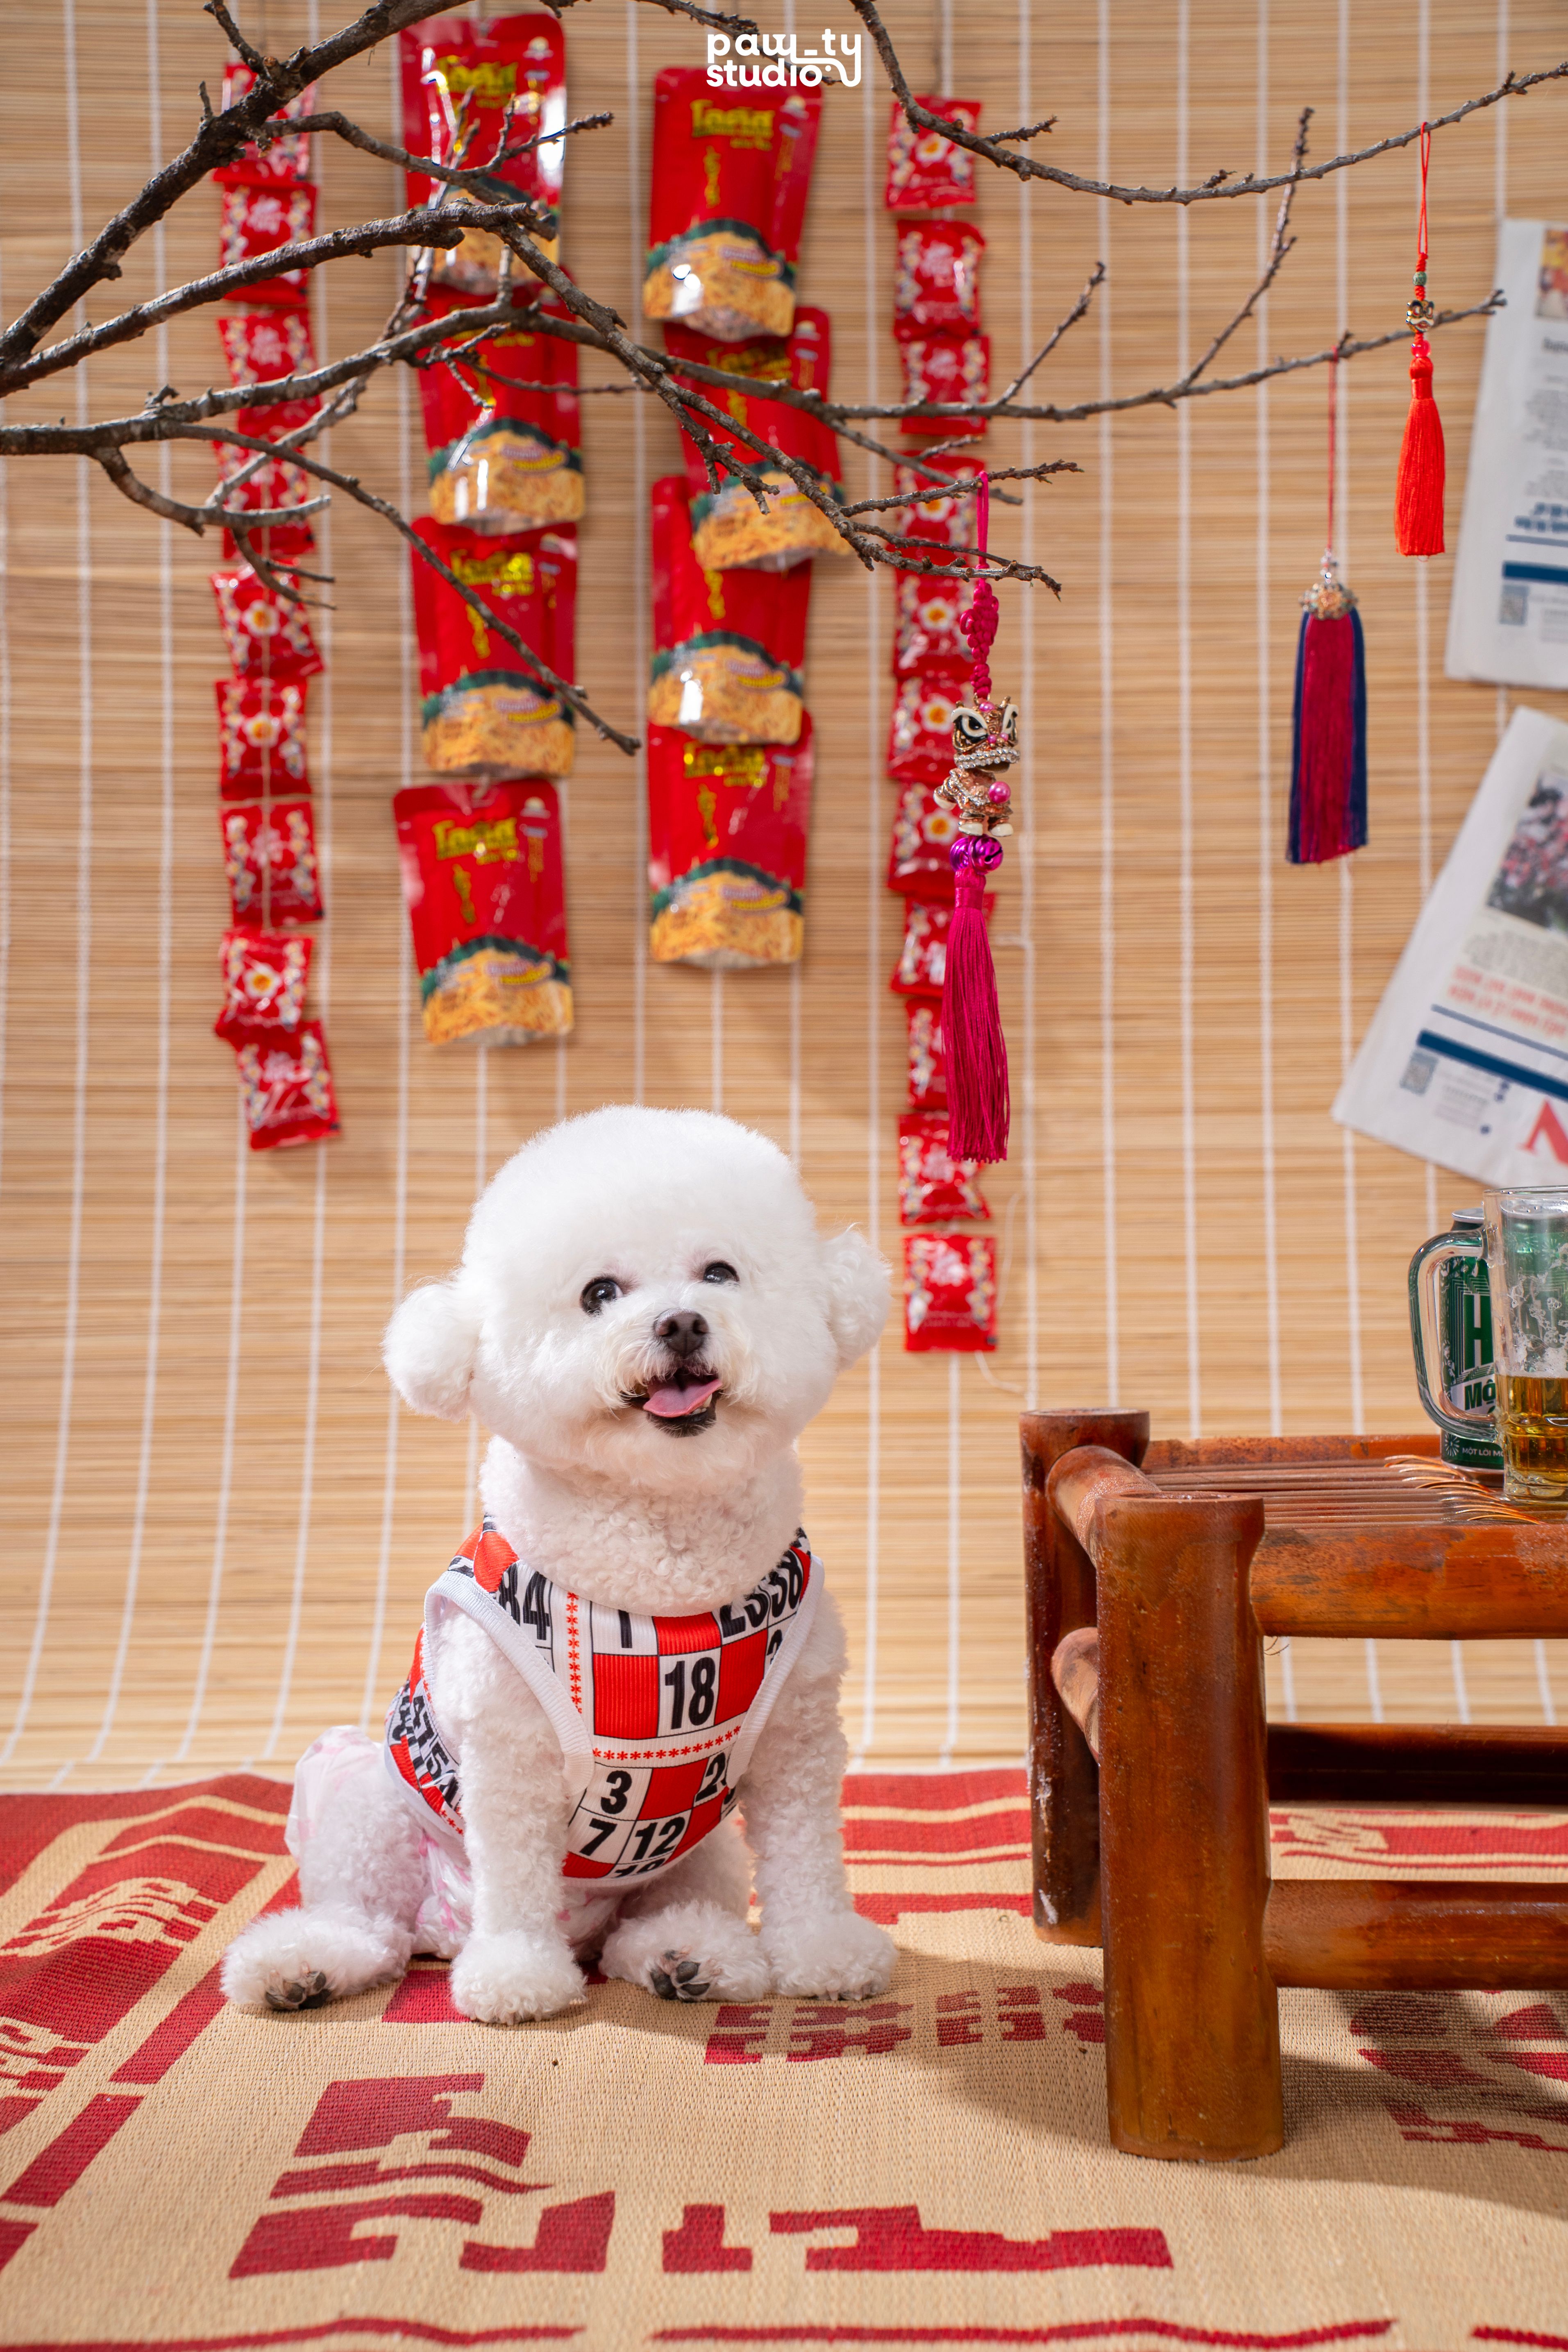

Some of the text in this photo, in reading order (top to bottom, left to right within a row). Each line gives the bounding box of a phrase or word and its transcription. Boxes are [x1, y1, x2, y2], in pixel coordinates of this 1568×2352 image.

[665, 1657, 715, 1729] 18
[601, 1770, 632, 1814] 3
[695, 1752, 728, 1802] 2
[579, 1817, 685, 1861] 7 12
